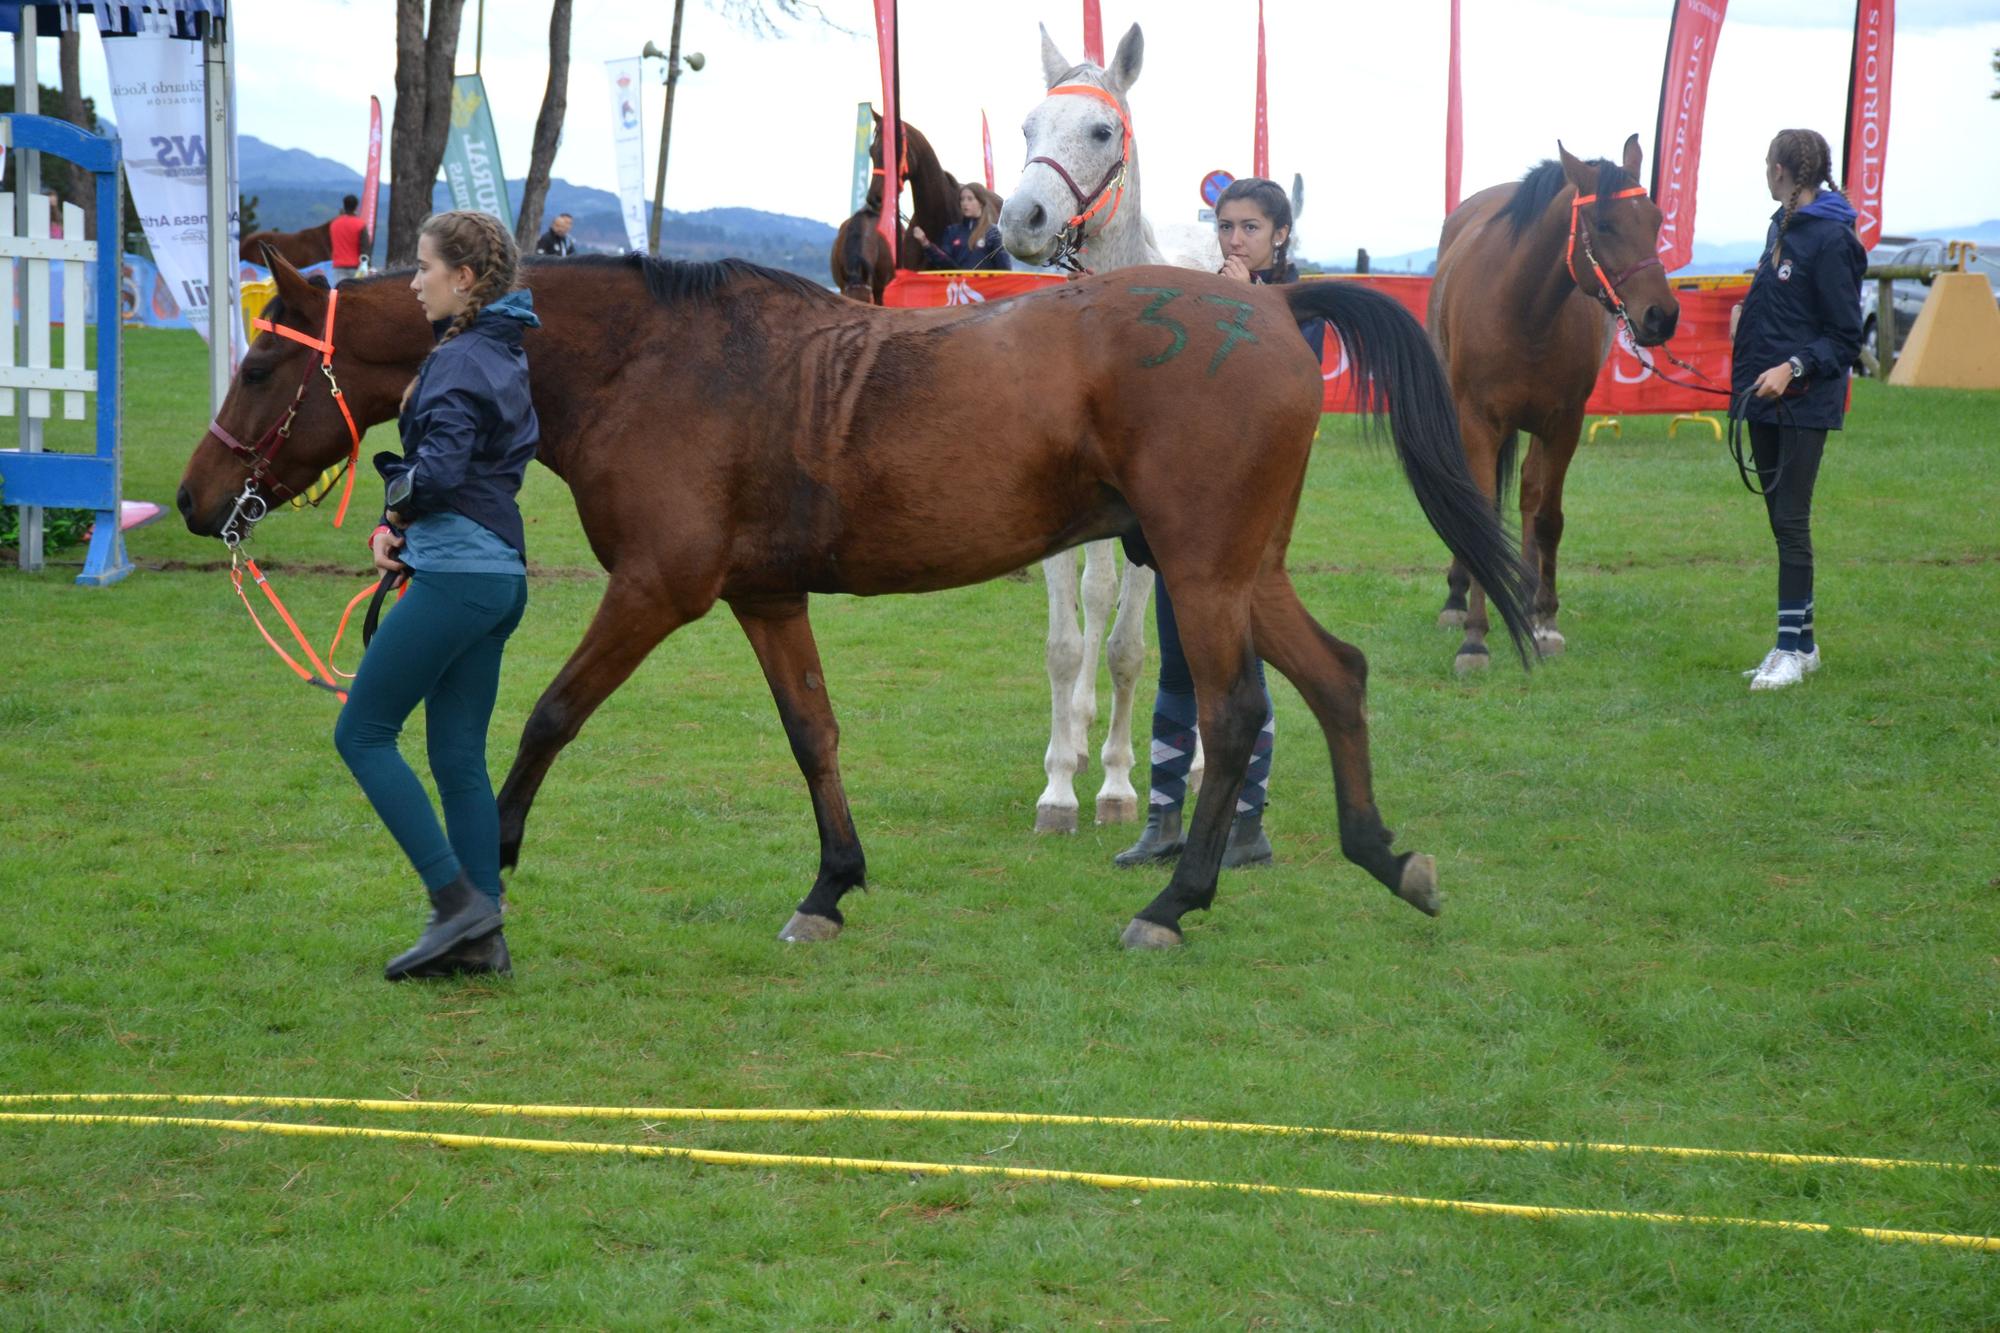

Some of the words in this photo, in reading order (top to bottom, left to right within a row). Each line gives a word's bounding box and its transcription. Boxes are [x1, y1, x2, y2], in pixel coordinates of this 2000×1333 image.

[1658, 34, 1704, 254] VICTORIOUS
[1859, 8, 1880, 234] VICTORIOUS
[1128, 286, 1261, 378] 37
